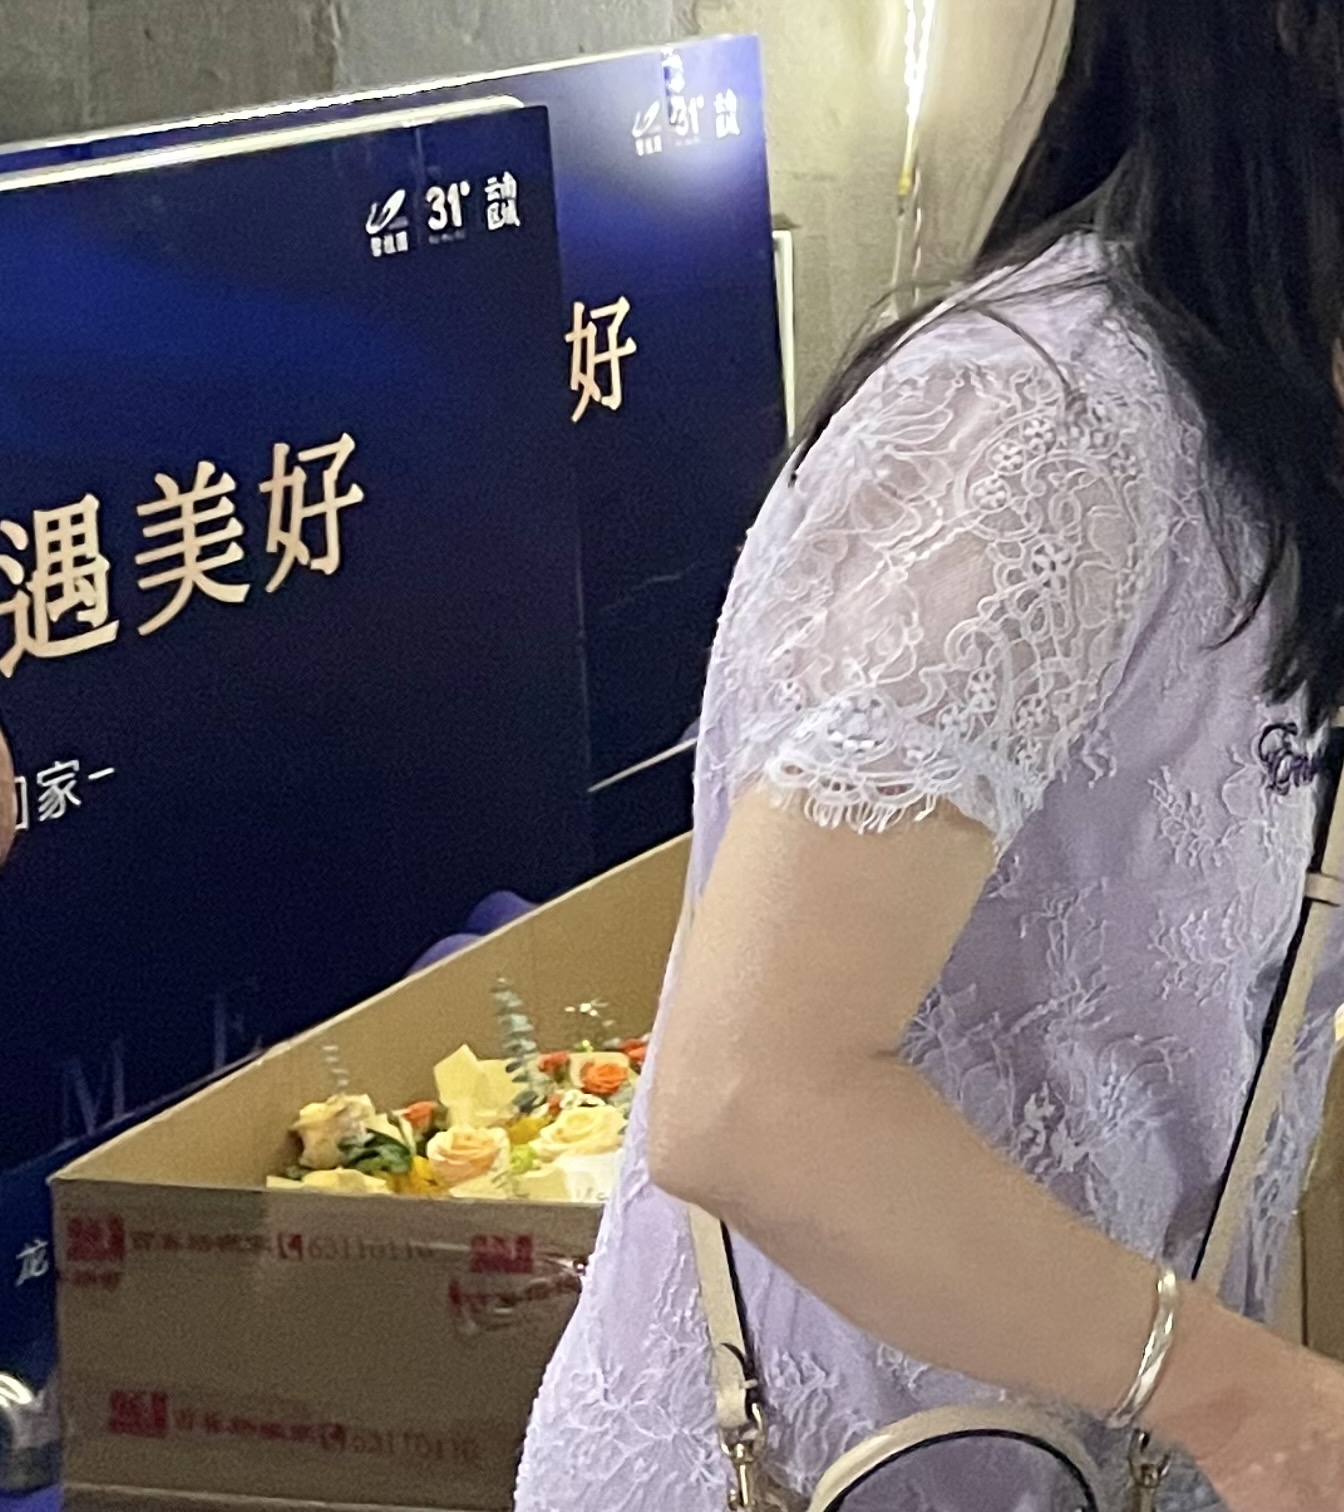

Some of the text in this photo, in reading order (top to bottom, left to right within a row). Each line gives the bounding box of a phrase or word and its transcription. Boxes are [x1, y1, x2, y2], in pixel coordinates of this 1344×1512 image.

[565, 295, 637, 423] 好
[0, 432, 364, 678] 遇美好
